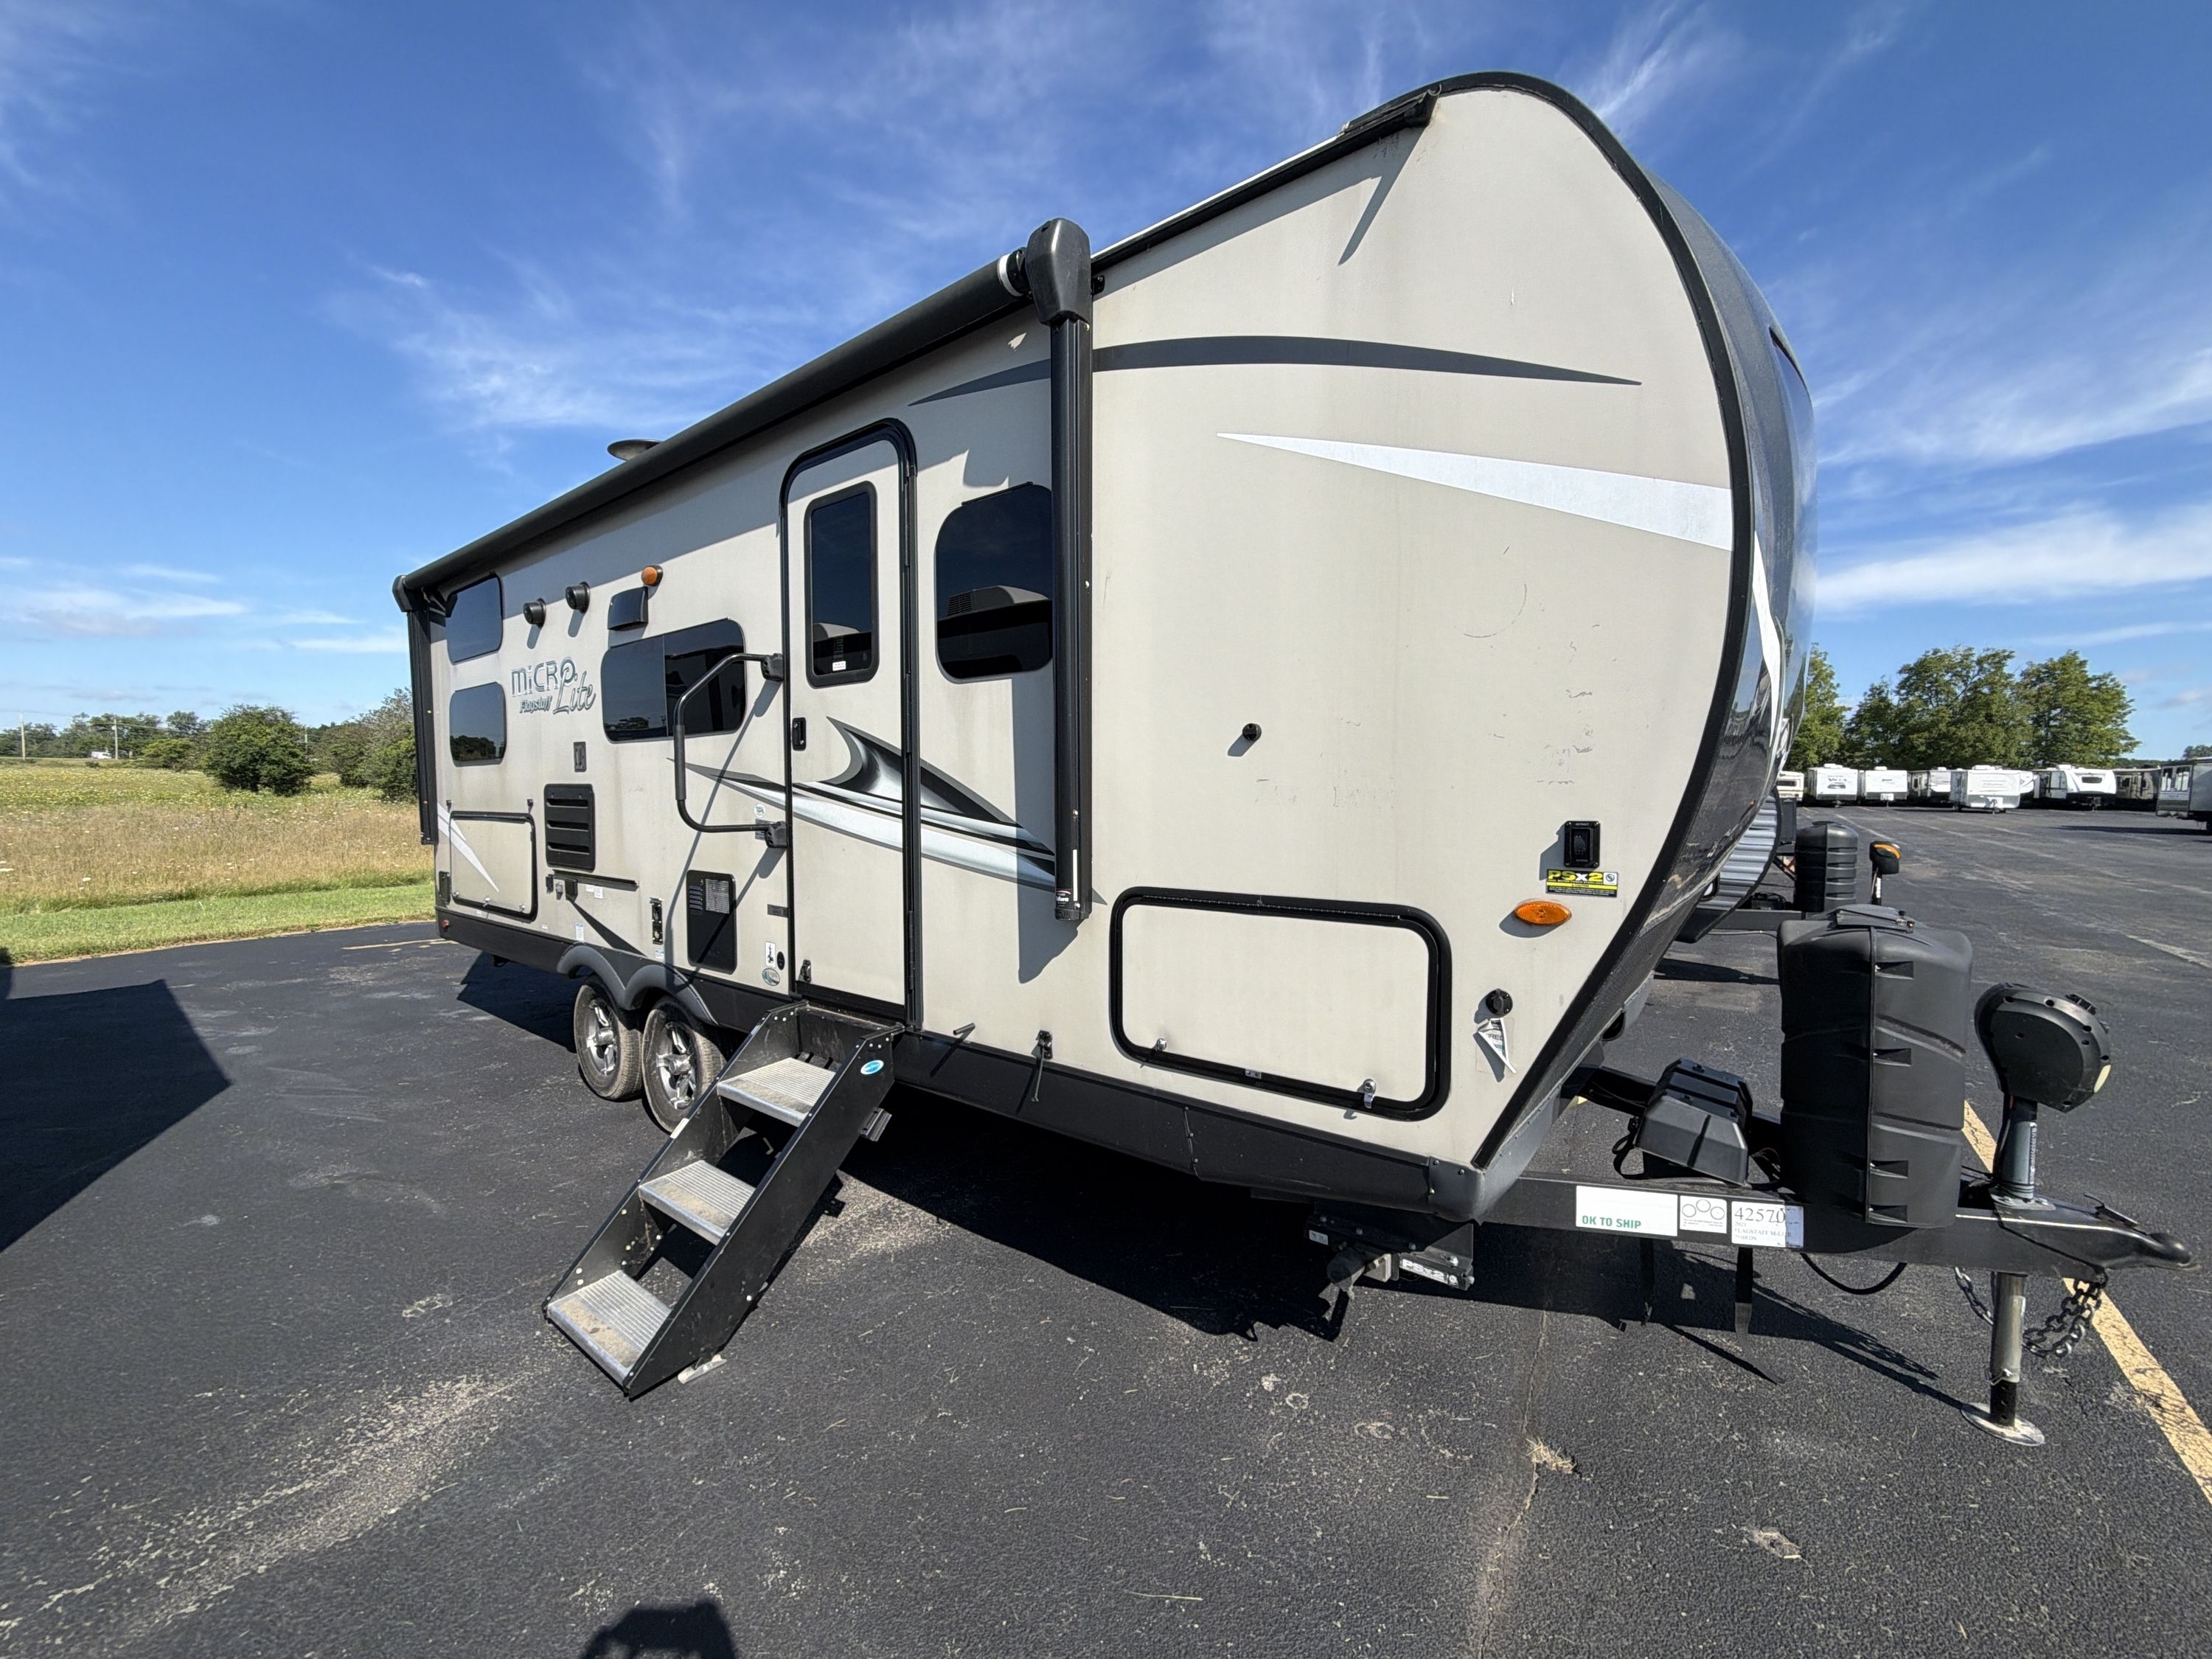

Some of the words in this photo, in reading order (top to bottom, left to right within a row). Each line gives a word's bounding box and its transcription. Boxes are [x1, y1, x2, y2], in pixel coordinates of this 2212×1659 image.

[553, 670, 597, 715] Lite
[519, 695, 553, 714] Flagstaff
[1548, 870, 1603, 882] PSx2
[1582, 1215, 1597, 1225] OK
[1599, 1217, 1613, 1227] TO
[1616, 1218, 1641, 1229] SHIP
[1734, 1207, 1786, 1223] 42570
[1734, 1227, 1769, 1236] FLAGSTAFF
